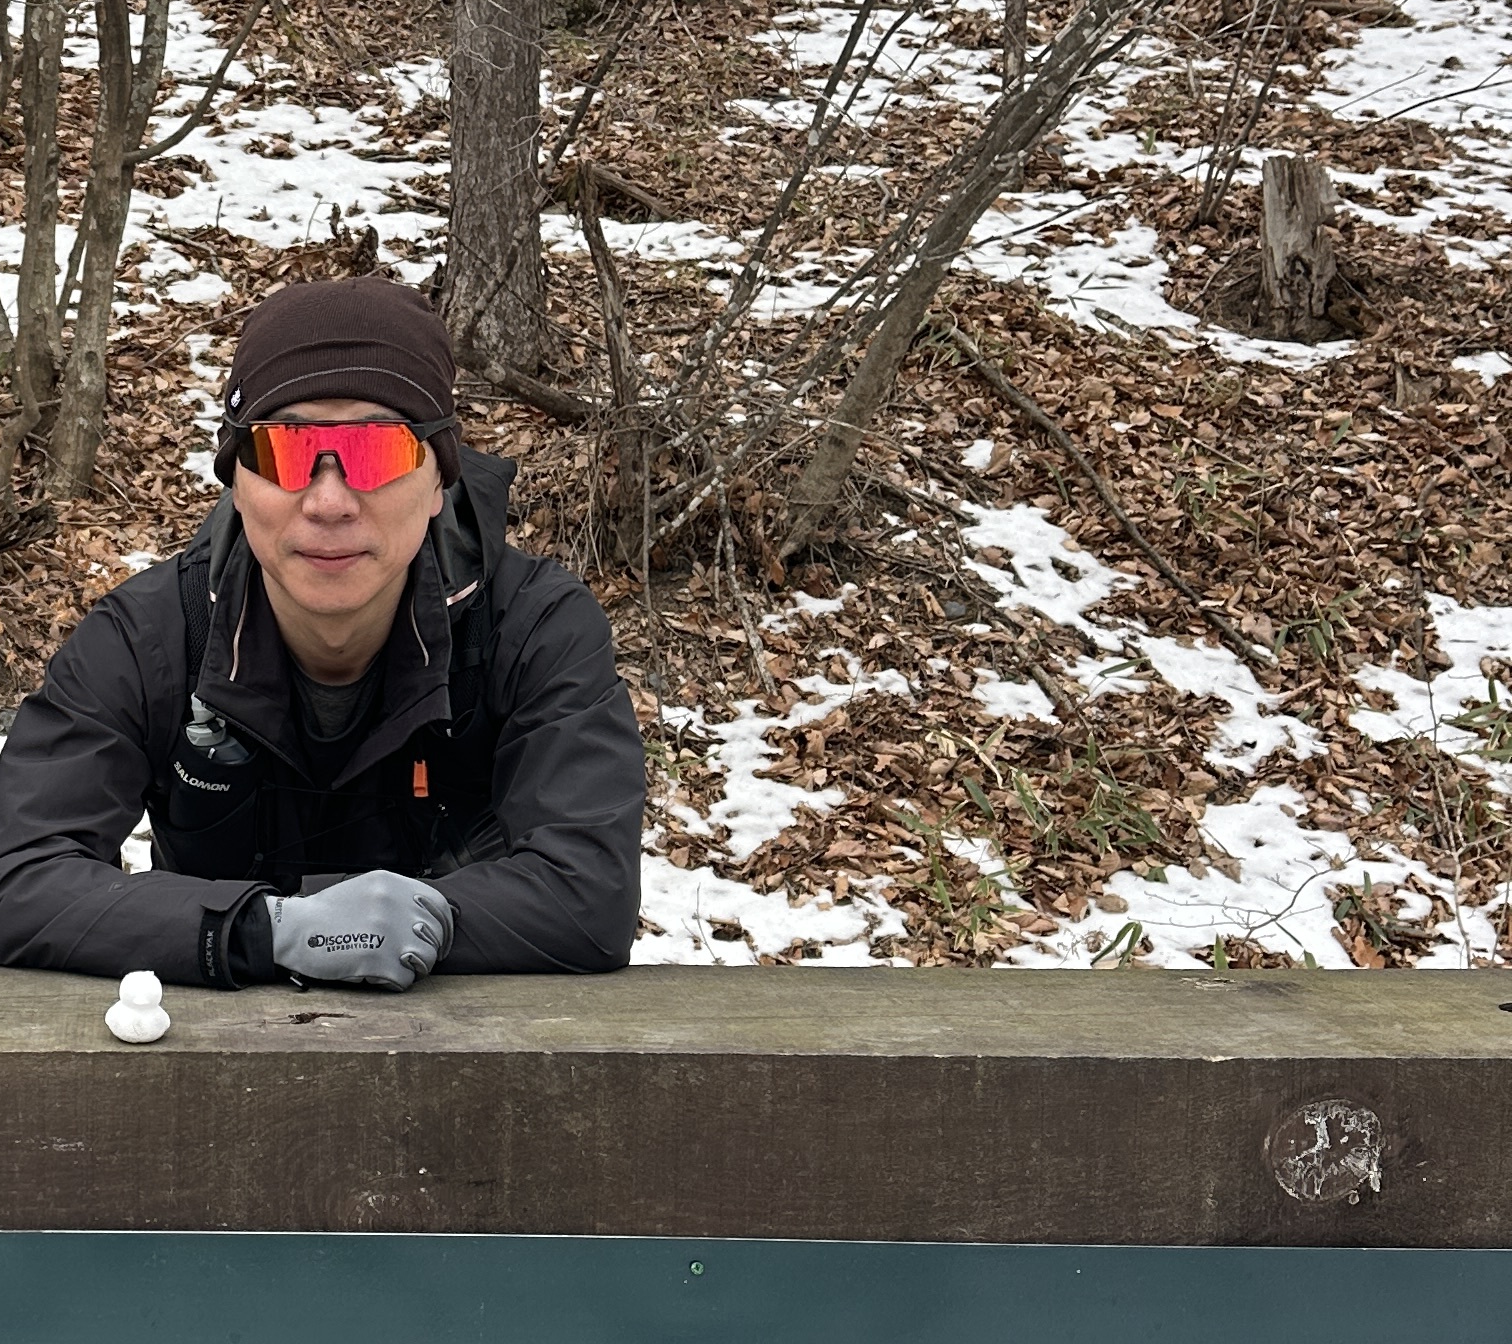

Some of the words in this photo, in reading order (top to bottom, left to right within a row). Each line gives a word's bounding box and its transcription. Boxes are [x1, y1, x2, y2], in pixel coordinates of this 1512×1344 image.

[174, 761, 231, 792] SALOMON
[314, 933, 385, 949] Discovery
[326, 942, 375, 953] EXPEDITION
